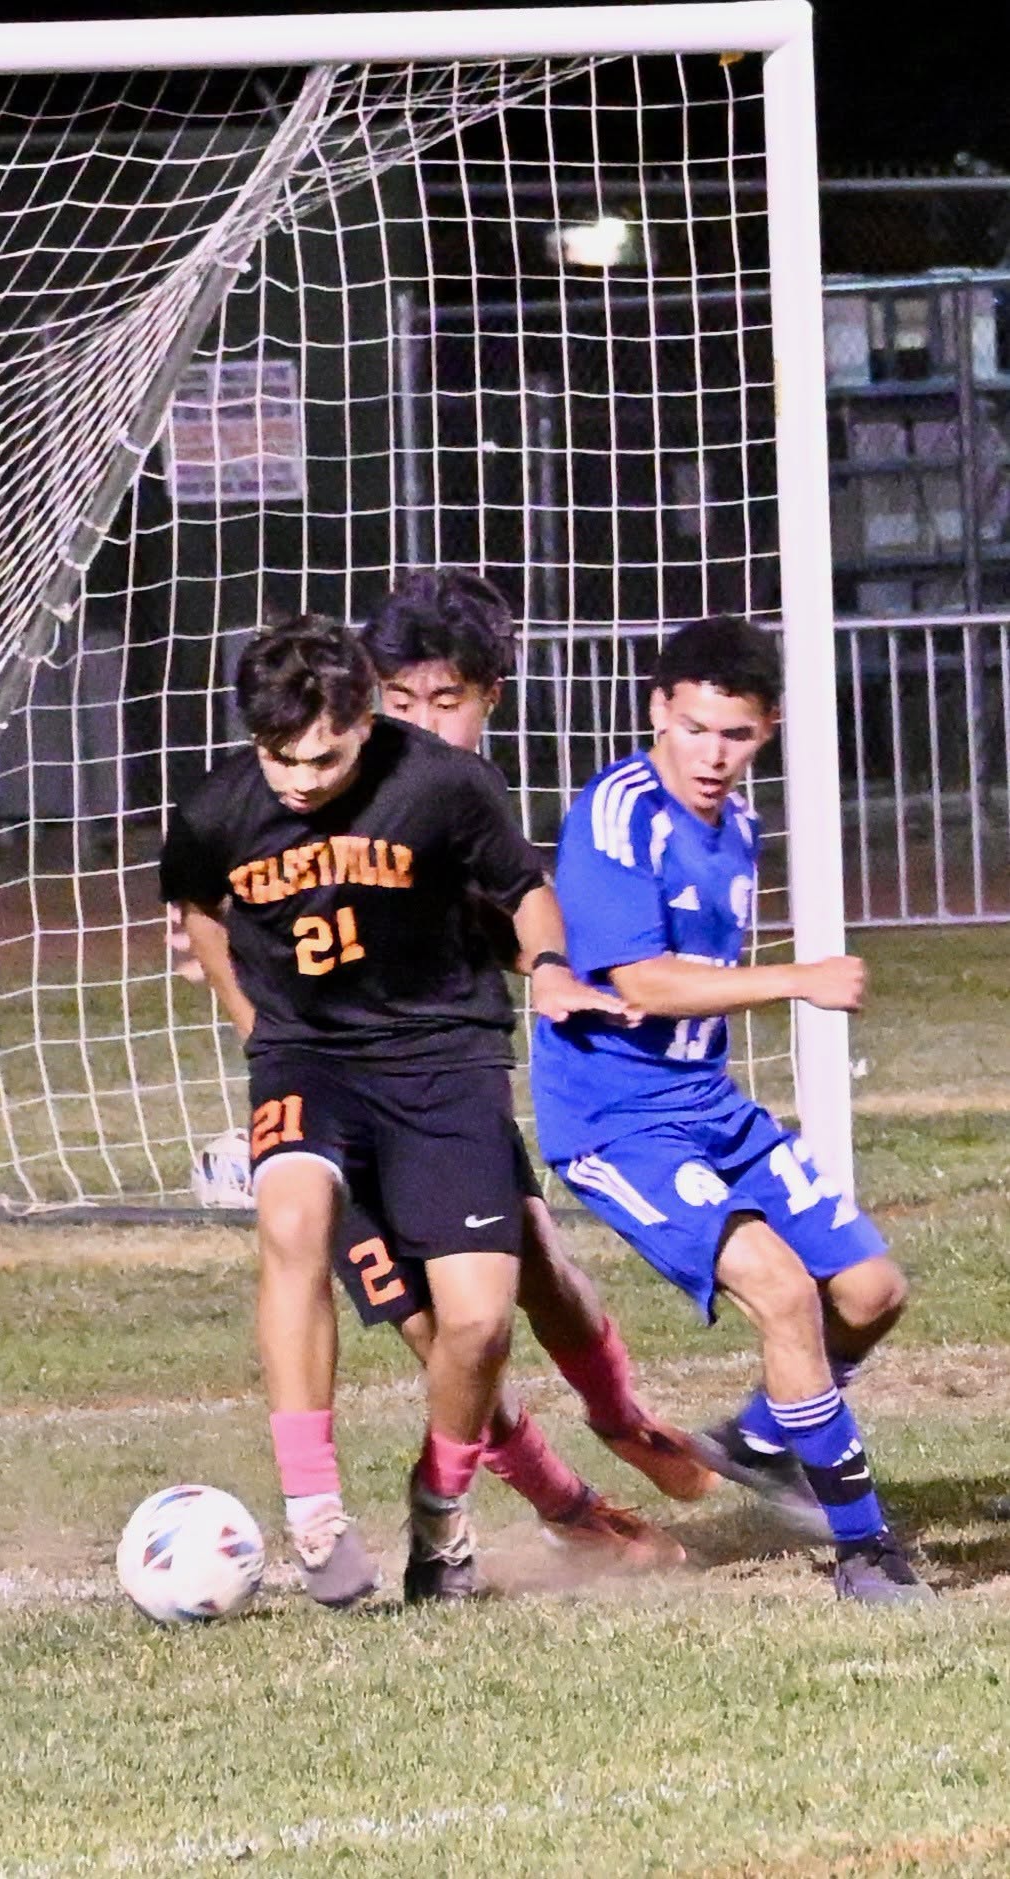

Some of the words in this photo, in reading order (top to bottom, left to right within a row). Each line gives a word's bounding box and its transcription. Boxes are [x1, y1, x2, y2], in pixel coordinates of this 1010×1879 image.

[293, 906, 366, 976] 21
[251, 1095, 305, 1159] 21
[349, 1237, 406, 1306] 2
